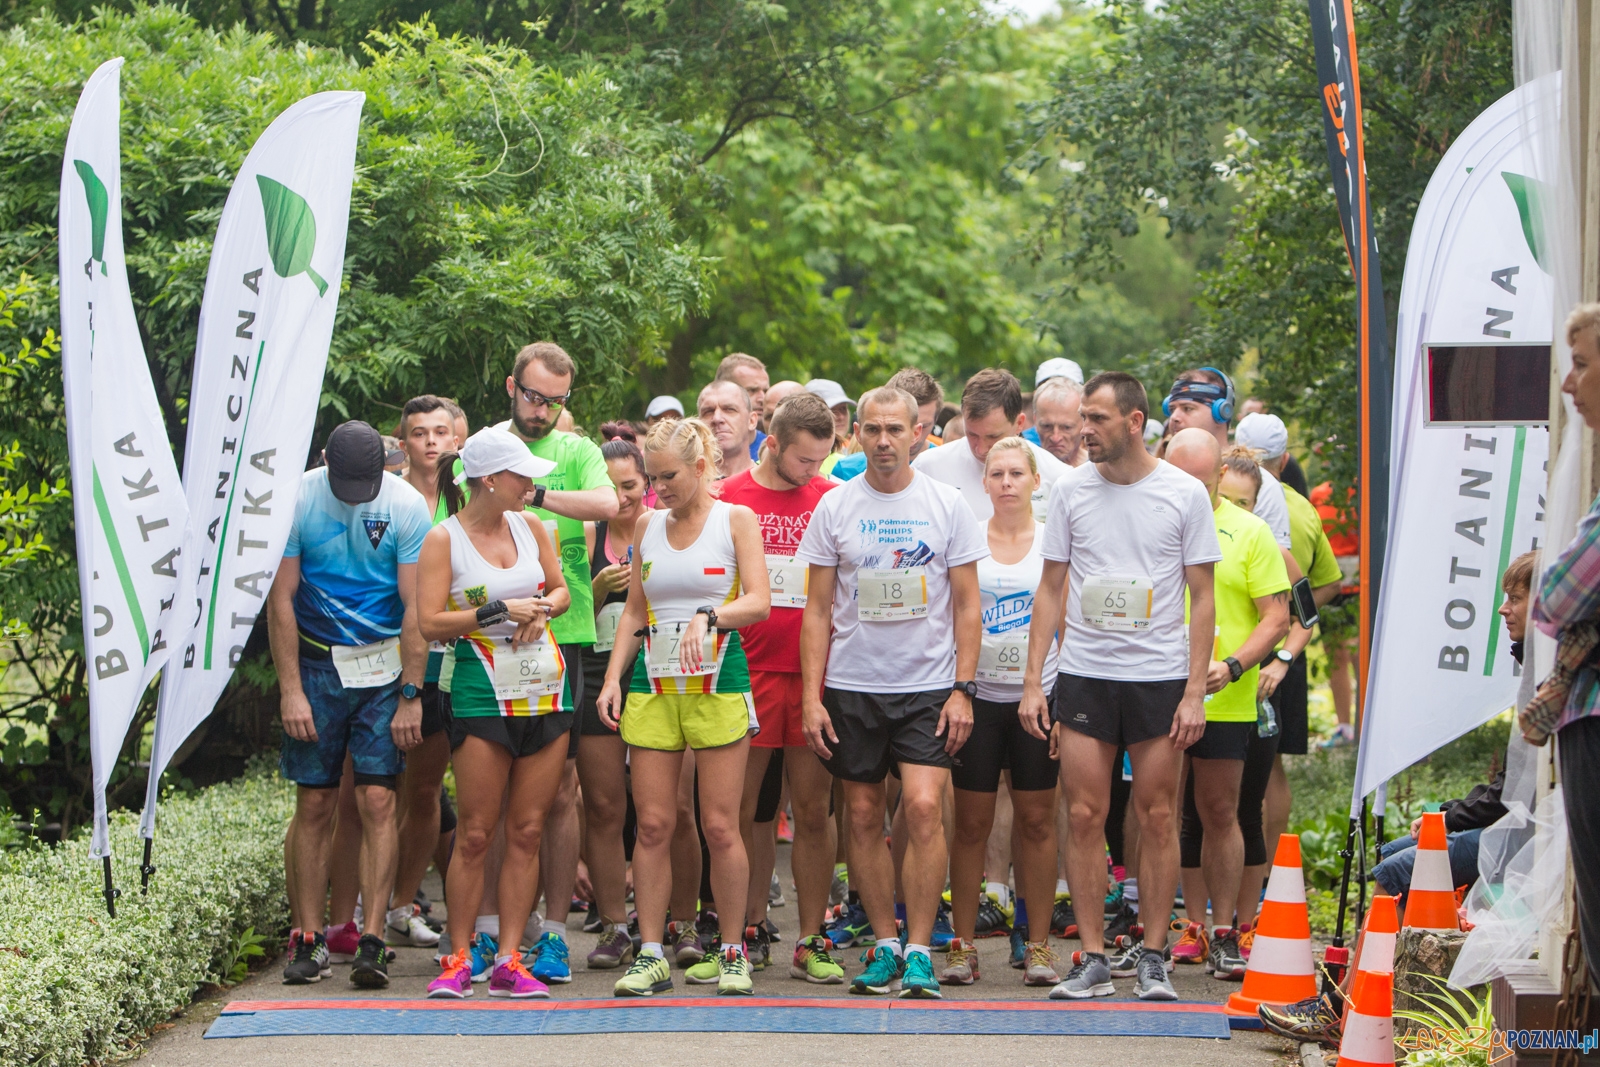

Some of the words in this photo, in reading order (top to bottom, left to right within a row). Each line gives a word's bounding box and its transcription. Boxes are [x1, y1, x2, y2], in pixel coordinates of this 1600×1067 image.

[878, 527, 913, 535] PHILIPS
[878, 536, 895, 544] Piła
[881, 582, 903, 600] 18
[1104, 591, 1127, 609] 65
[354, 652, 386, 671] 114
[998, 646, 1020, 664] 68
[519, 658, 541, 677] 82
